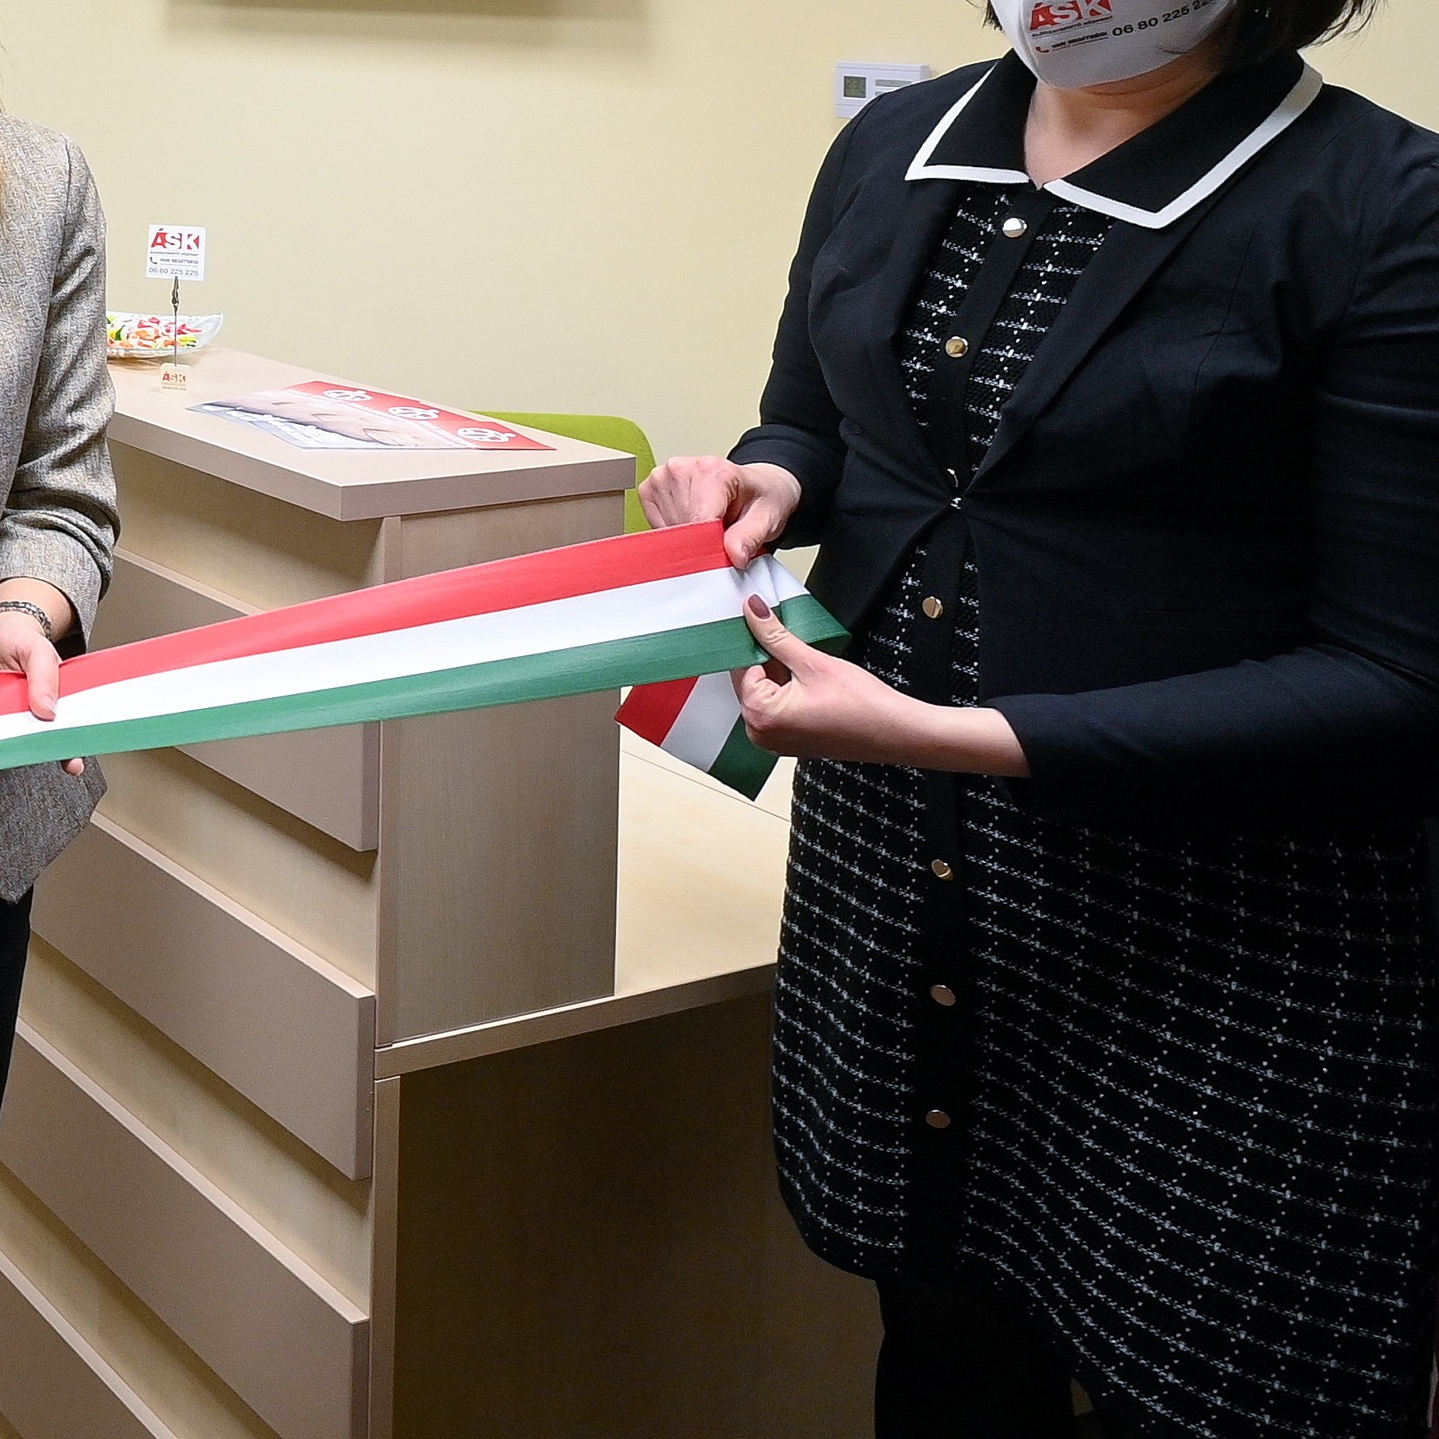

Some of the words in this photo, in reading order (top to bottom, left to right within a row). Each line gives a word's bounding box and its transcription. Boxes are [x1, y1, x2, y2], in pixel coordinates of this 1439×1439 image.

[1112, 24, 1134, 37] 06
[1138, 17, 1159, 30] 80
[1162, 5, 1190, 23] 225
[150, 228, 200, 251] ÁSK
